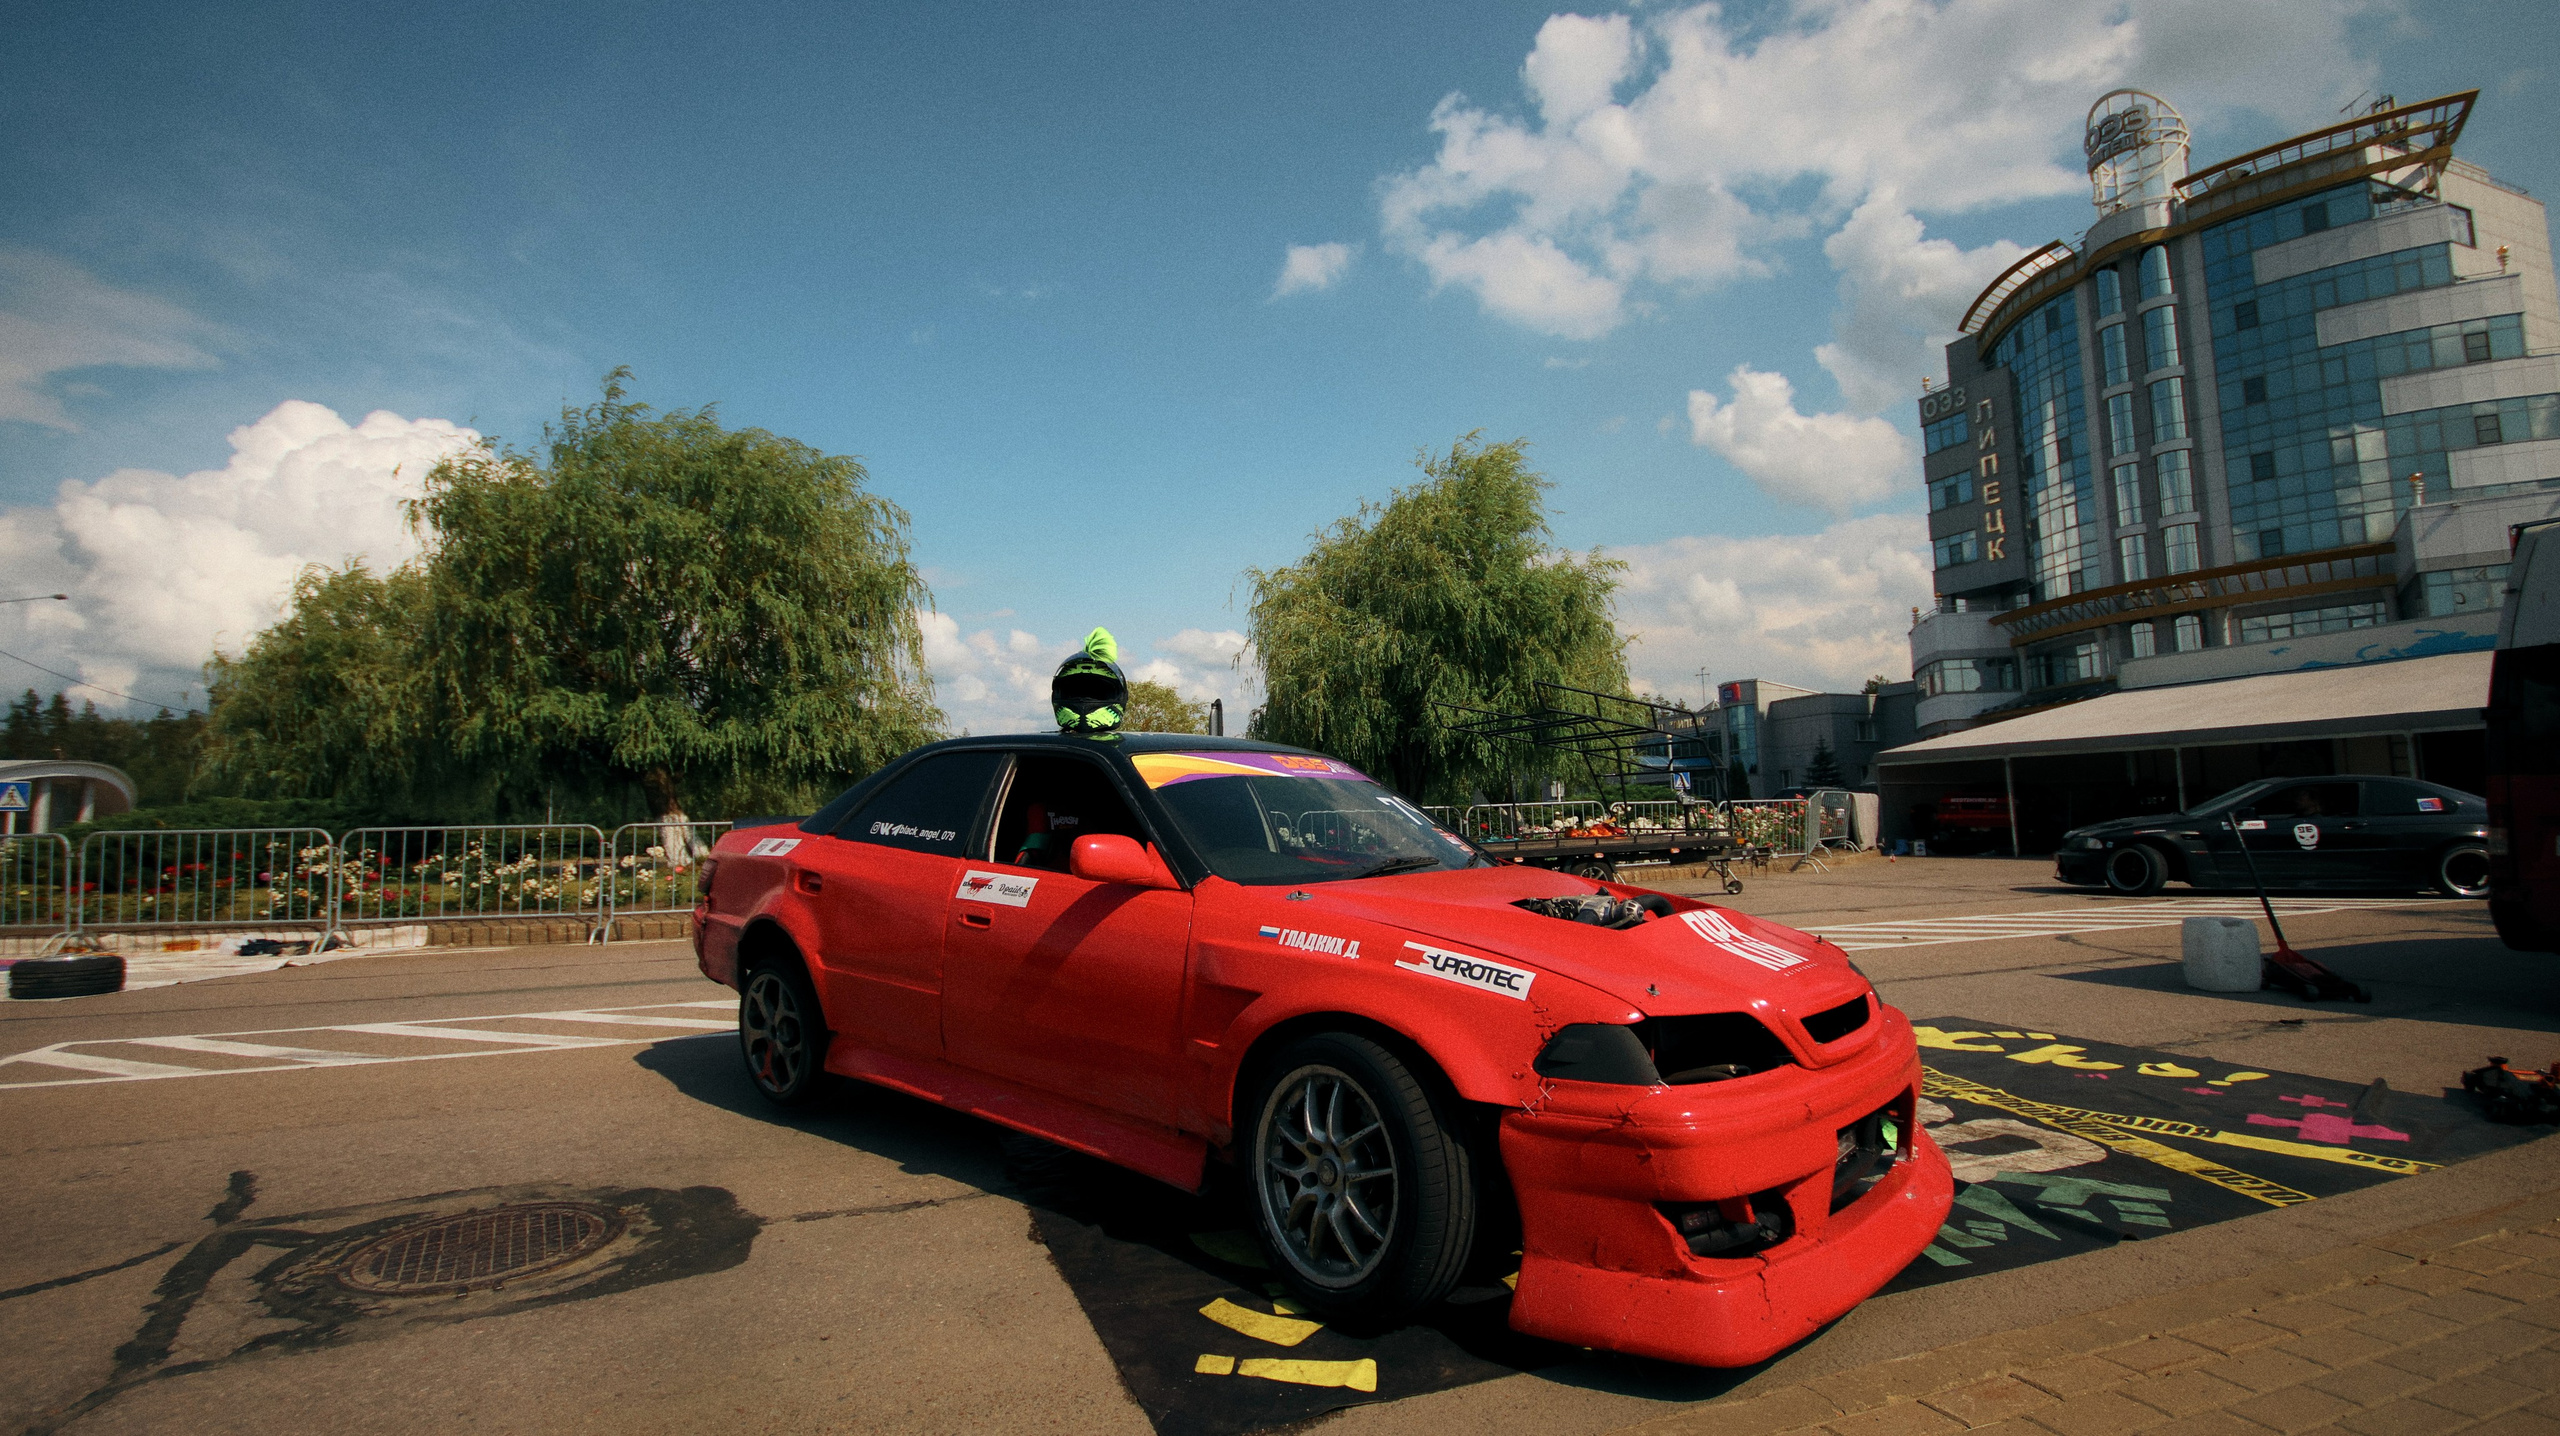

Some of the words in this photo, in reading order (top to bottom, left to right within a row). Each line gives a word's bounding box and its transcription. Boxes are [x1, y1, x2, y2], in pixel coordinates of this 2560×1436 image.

[1923, 387, 1967, 418] ОЭЗ
[1974, 398, 2006, 562] ЛИПЕЦК
[1278, 929, 1346, 956] ГЛАДКИХ
